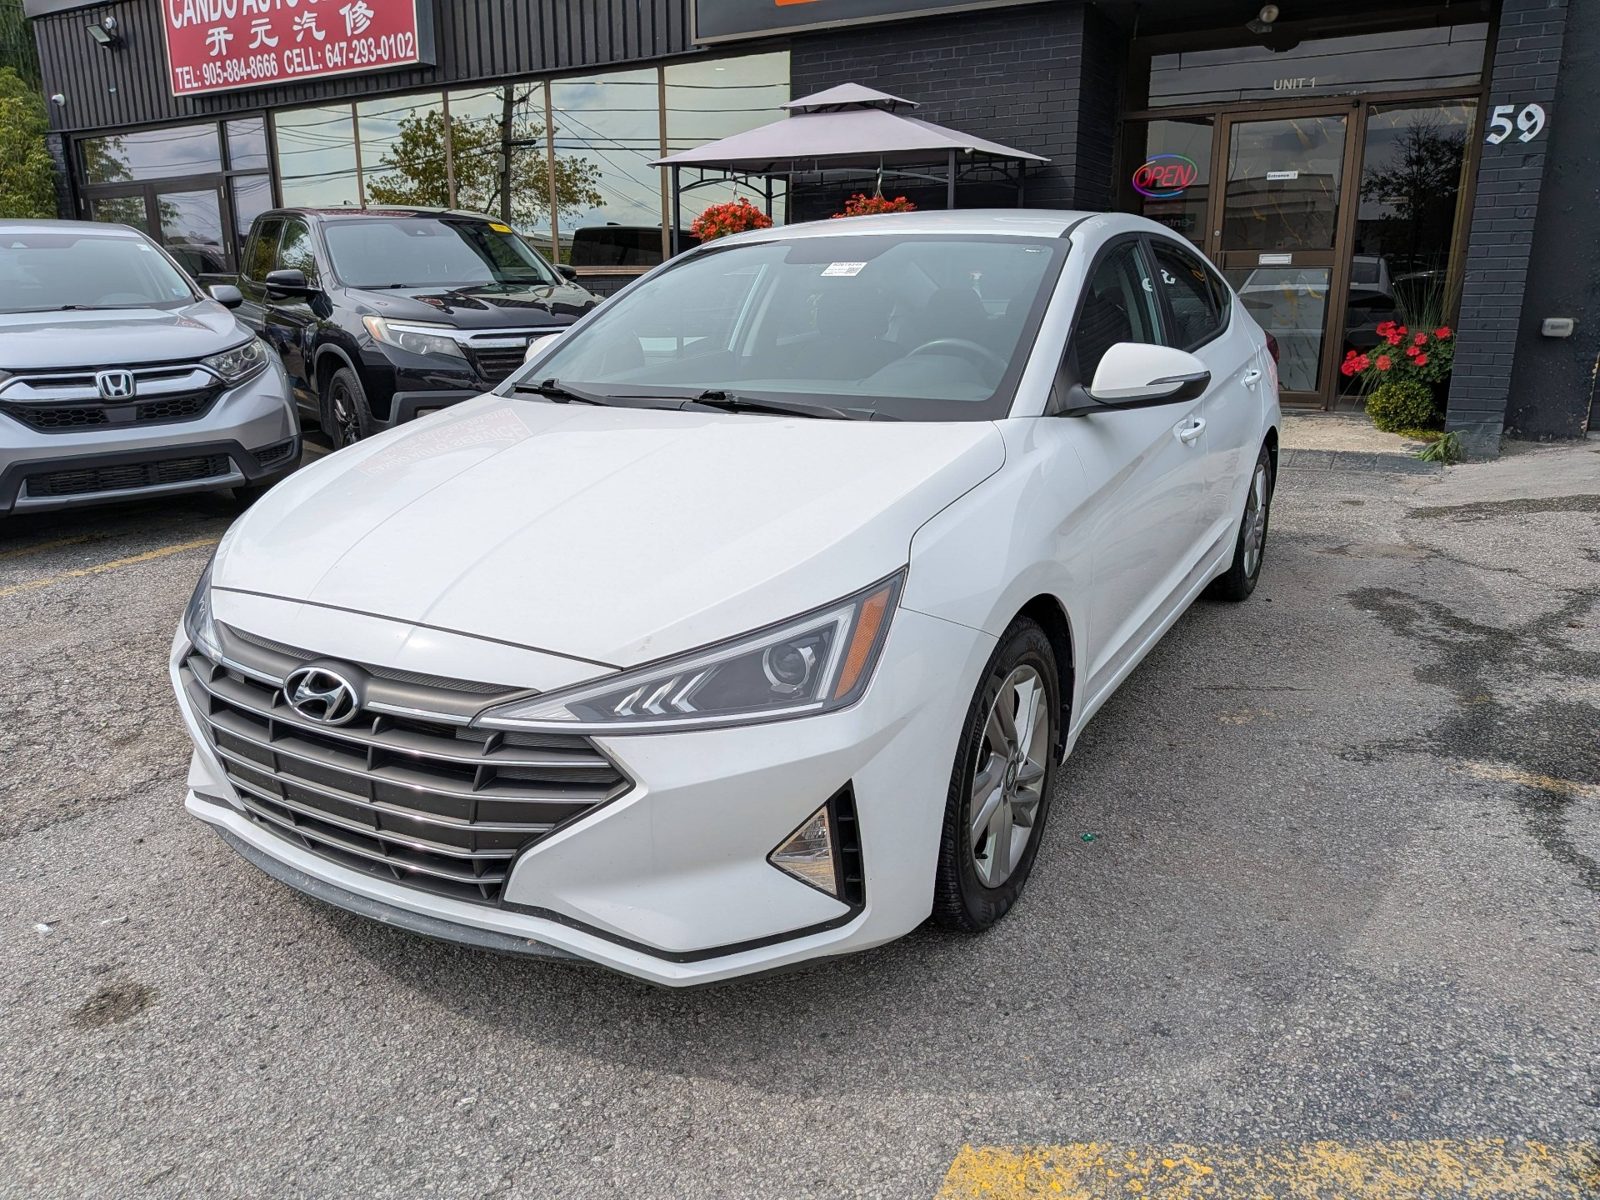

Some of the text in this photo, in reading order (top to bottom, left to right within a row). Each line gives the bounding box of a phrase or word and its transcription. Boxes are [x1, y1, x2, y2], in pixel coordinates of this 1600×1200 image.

[205, 1, 374, 56] 开元汽修
[176, 31, 414, 89] TEL: 905-884-8666 CELL: 647-293-0102
[1273, 76, 1316, 91] UNIT 1
[1486, 103, 1545, 145] 59
[1135, 164, 1192, 187] OPEN
